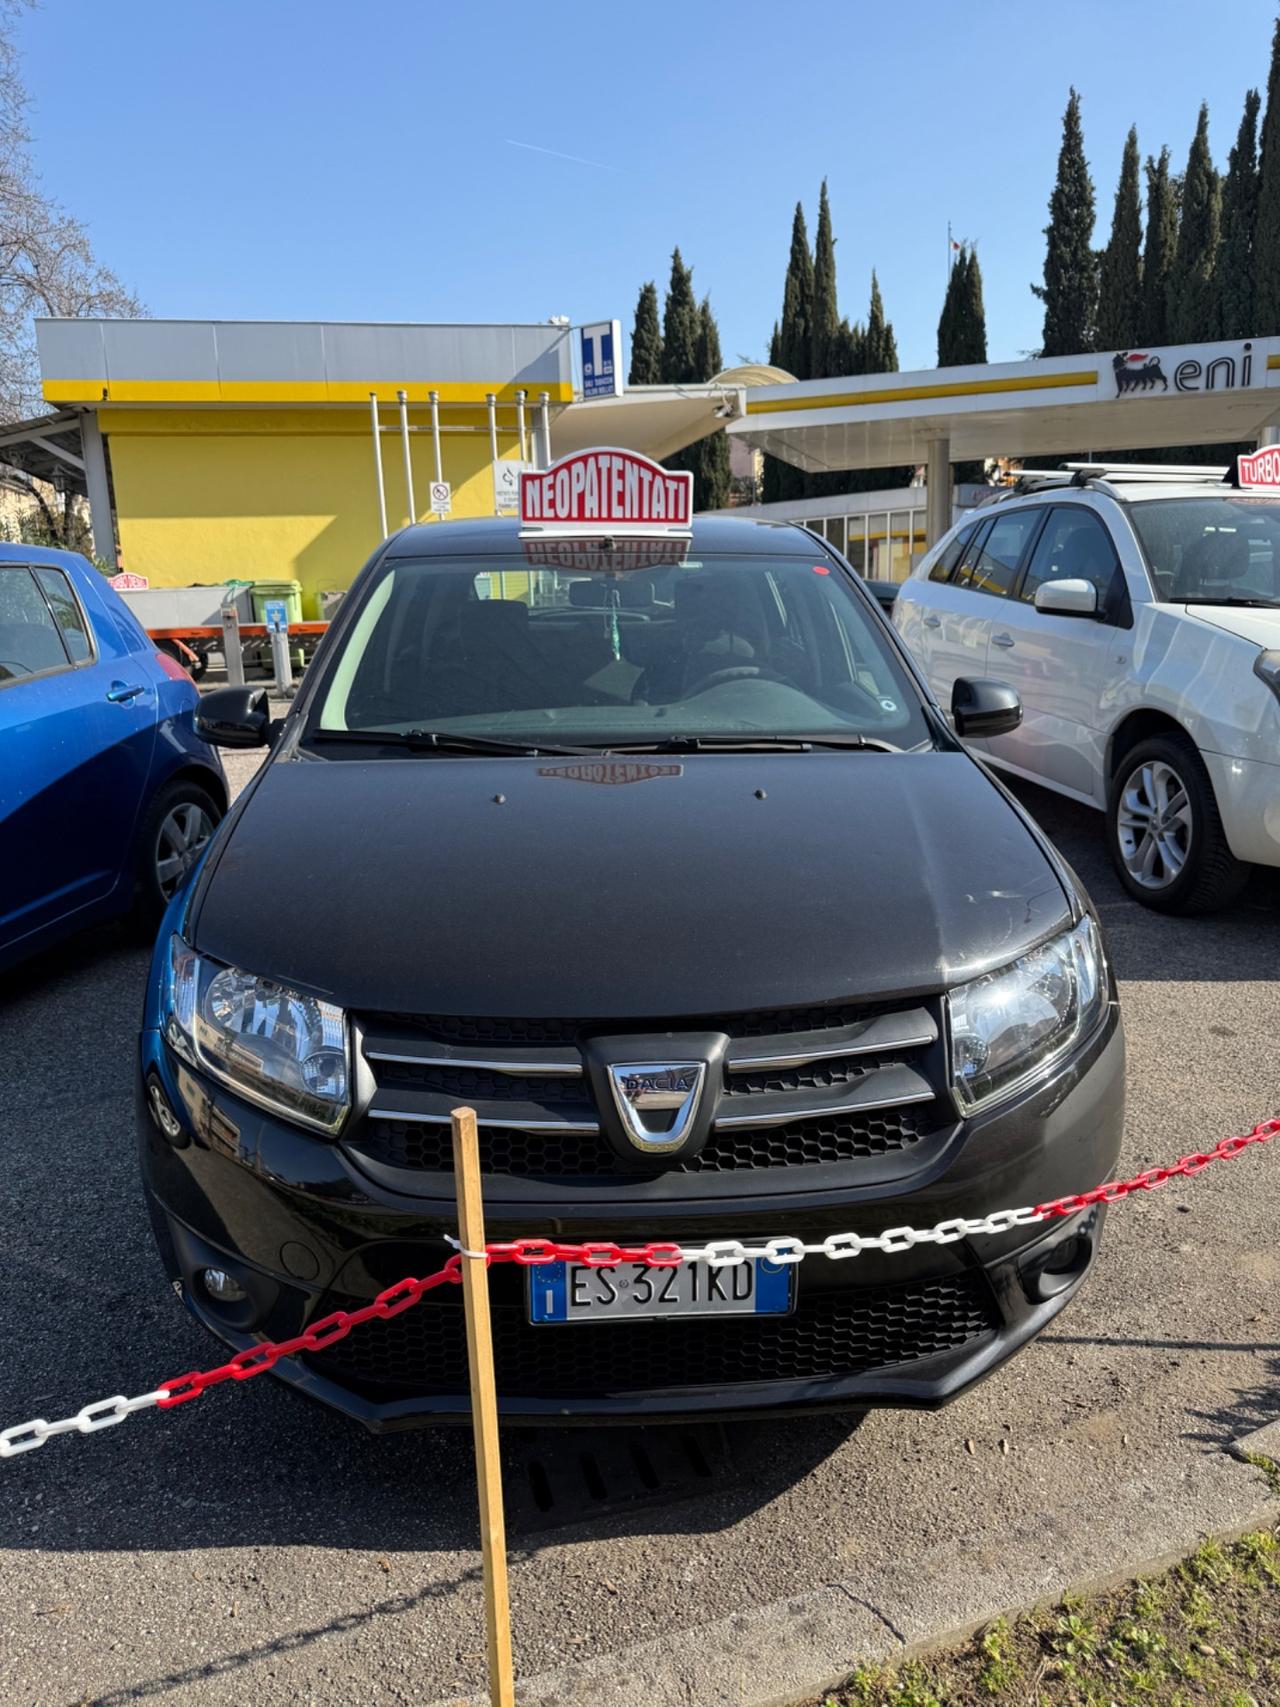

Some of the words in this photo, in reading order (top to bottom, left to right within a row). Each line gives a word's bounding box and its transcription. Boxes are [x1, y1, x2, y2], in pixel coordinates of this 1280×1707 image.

[583, 323, 610, 376] T
[1174, 343, 1252, 392] eni
[526, 455, 686, 520] NEOPATENTATI
[1242, 450, 1280, 484] TURBO
[626, 1078, 690, 1090] DACIA
[571, 1263, 618, 1307] ES
[632, 1260, 753, 1304] 321KD
